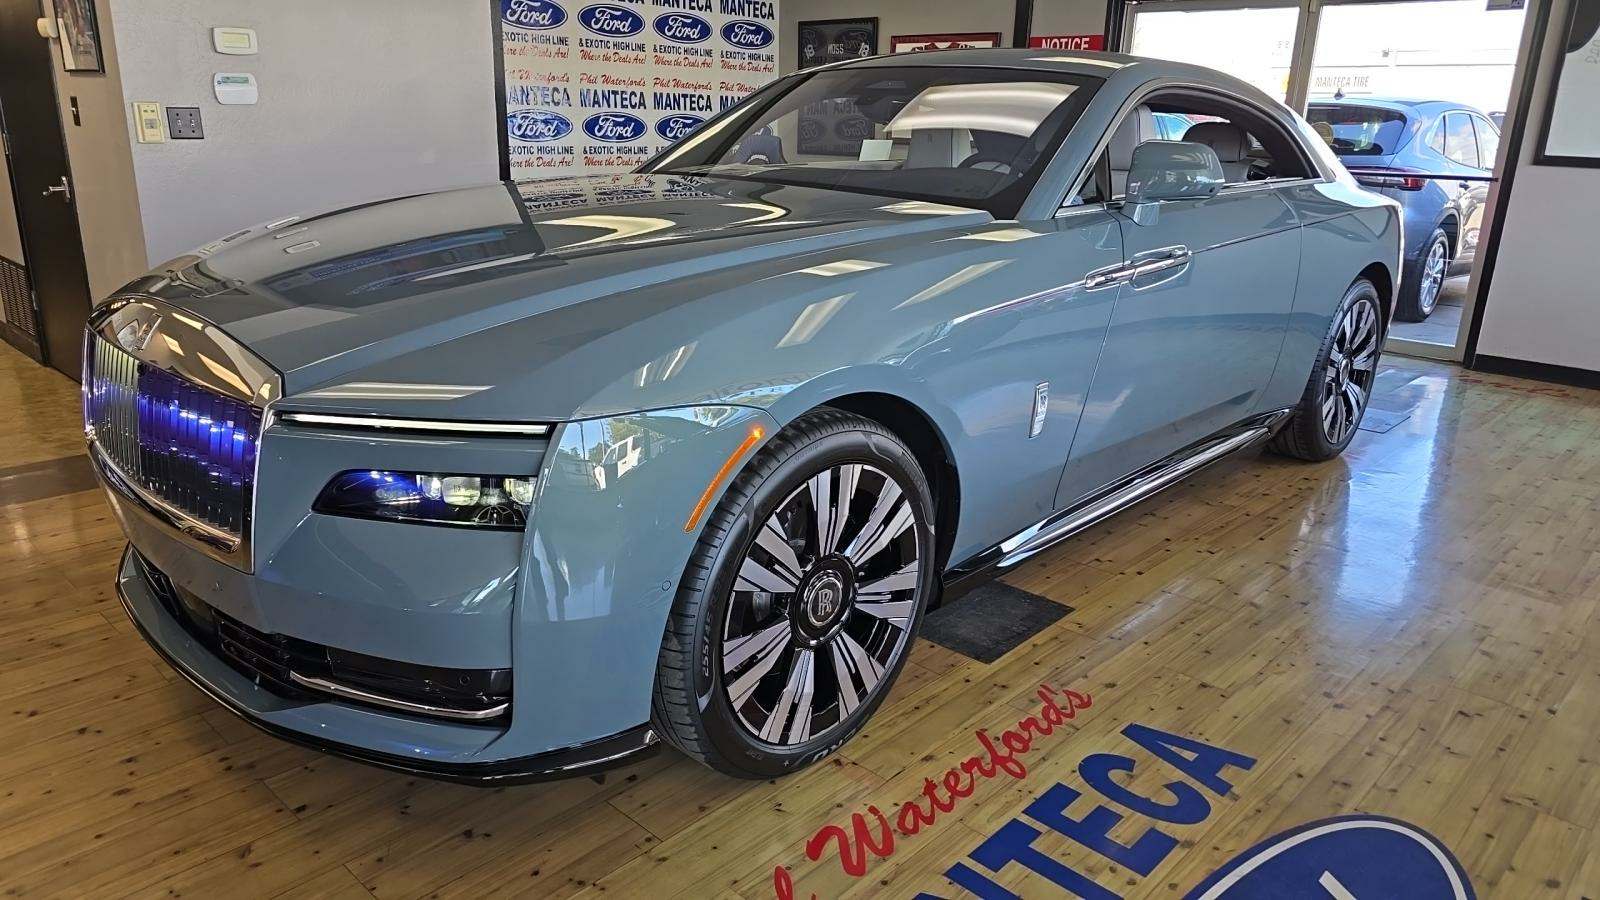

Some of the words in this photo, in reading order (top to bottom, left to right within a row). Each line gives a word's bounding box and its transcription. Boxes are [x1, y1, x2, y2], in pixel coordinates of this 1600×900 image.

[506, 0, 552, 24] Ford
[720, 0, 774, 20] MANTECA
[591, 8, 632, 32] Ford
[664, 16, 700, 39] Ford
[731, 23, 763, 45] Ford
[503, 31, 529, 43] XOTIC
[579, 37, 584, 47] &
[585, 39, 611, 50] EXOTIC
[1041, 37, 1090, 51] NOTICE
[653, 44, 658, 53] &
[659, 45, 681, 55] EXOTIC
[720, 50, 725, 59] &
[726, 51, 746, 60] EXOTIC
[827, 43, 844, 54] MOSS
[602, 51, 612, 62] the
[612, 52, 632, 64] Deals
[632, 54, 647, 65] Are!
[654, 55, 673, 66] Where
[673, 56, 683, 67] the
[683, 57, 699, 67] Deals
[699, 58, 714, 69] Are!
[720, 60, 737, 71] Where
[738, 61, 746, 71] the
[747, 62, 761, 72] Deals
[761, 63, 774, 73] Are!
[579, 72, 598, 84] Phil
[653, 77, 670, 88] Phil
[720, 81, 735, 92] Phil
[508, 85, 572, 107] ANTECA
[580, 88, 647, 110] MANTECA
[653, 92, 713, 112] MANTECA
[513, 112, 558, 136] Ford
[594, 115, 635, 137] Ford
[582, 145, 588, 155] &
[588, 145, 614, 155] EXOTIC
[525, 157, 535, 168] the
[536, 156, 557, 168] Deals
[558, 156, 575, 168] Are!
[583, 156, 603, 167] Where
[605, 156, 615, 167] the
[615, 156, 634, 167] Deals
[805, 683, 1093, 877] Waterford's
[911, 722, 1258, 900] TECA
